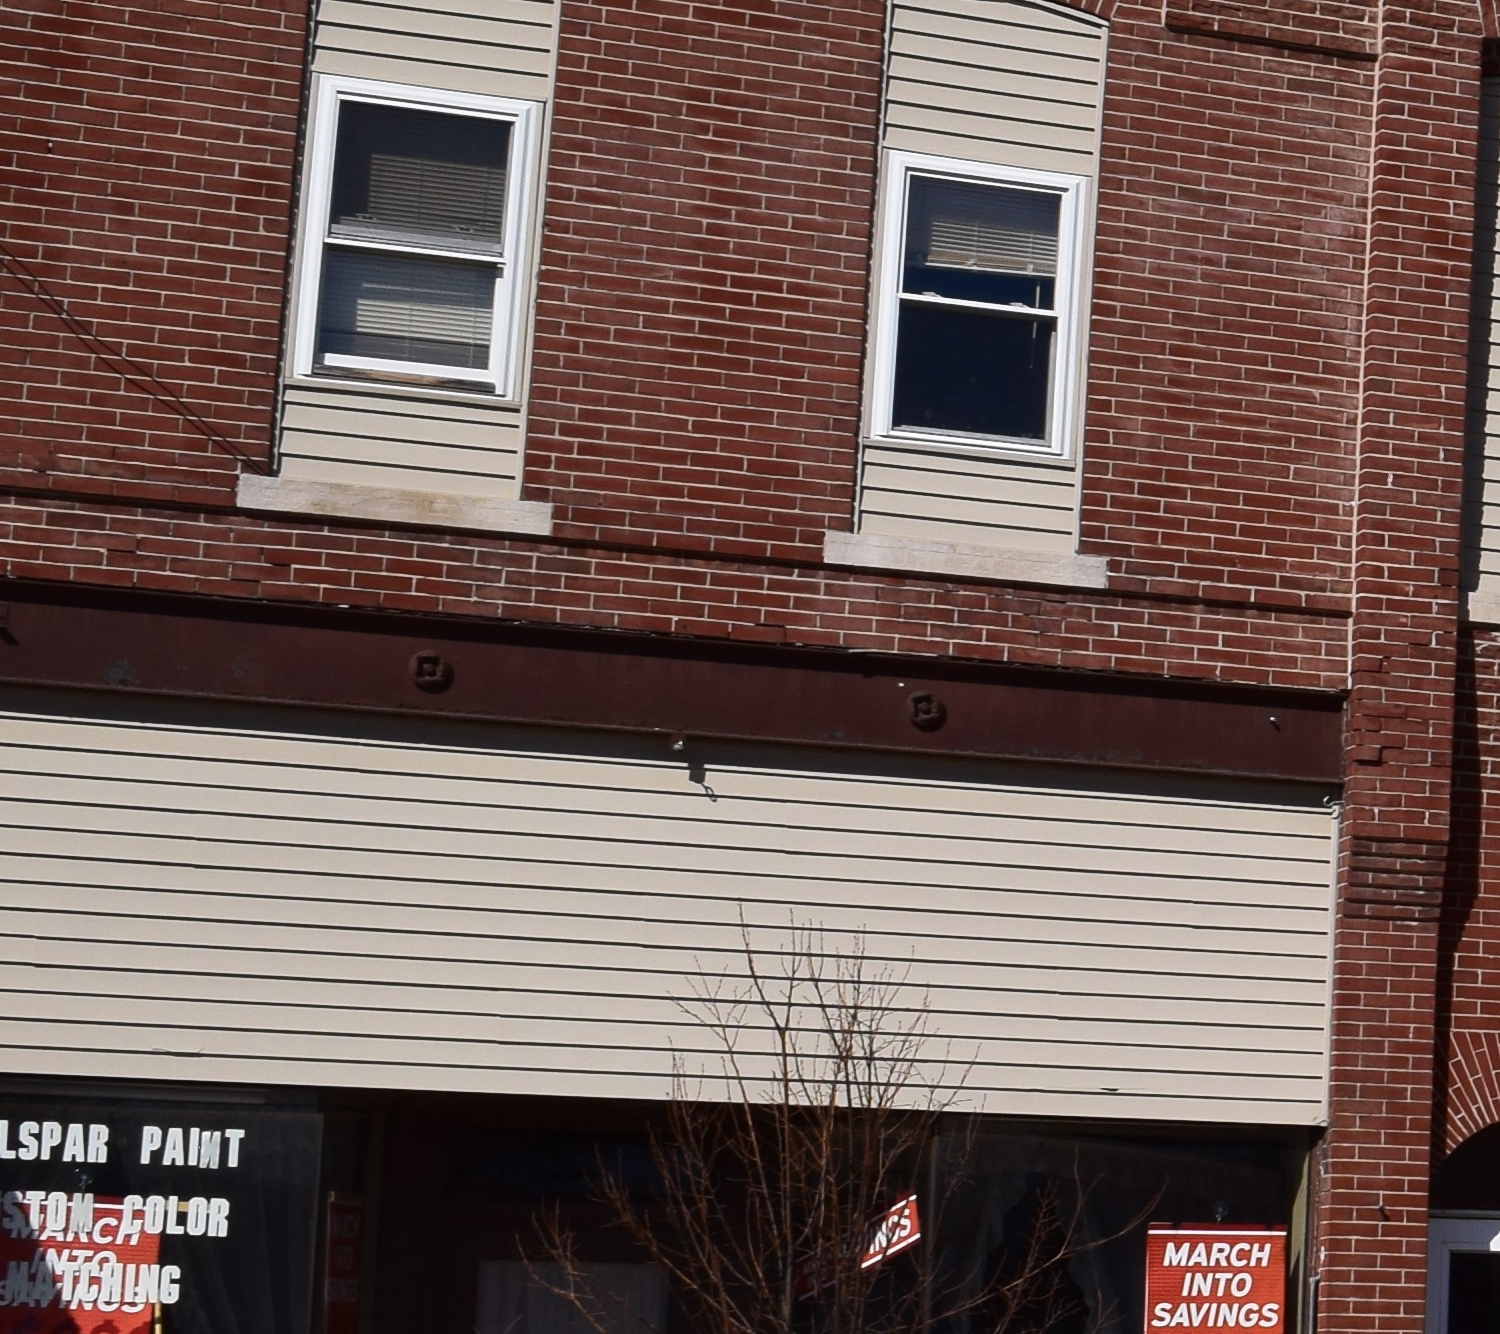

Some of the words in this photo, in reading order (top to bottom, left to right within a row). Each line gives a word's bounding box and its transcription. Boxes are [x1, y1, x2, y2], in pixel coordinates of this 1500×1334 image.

[140, 1125, 245, 1169] PAINT
[123, 1194, 230, 1238] COLOR
[1163, 1242, 1271, 1267] MARCH
[6, 1260, 181, 1304] MATCHING
[1182, 1272, 1253, 1298] INTO
[1151, 1302, 1280, 1328] SAVINGS
